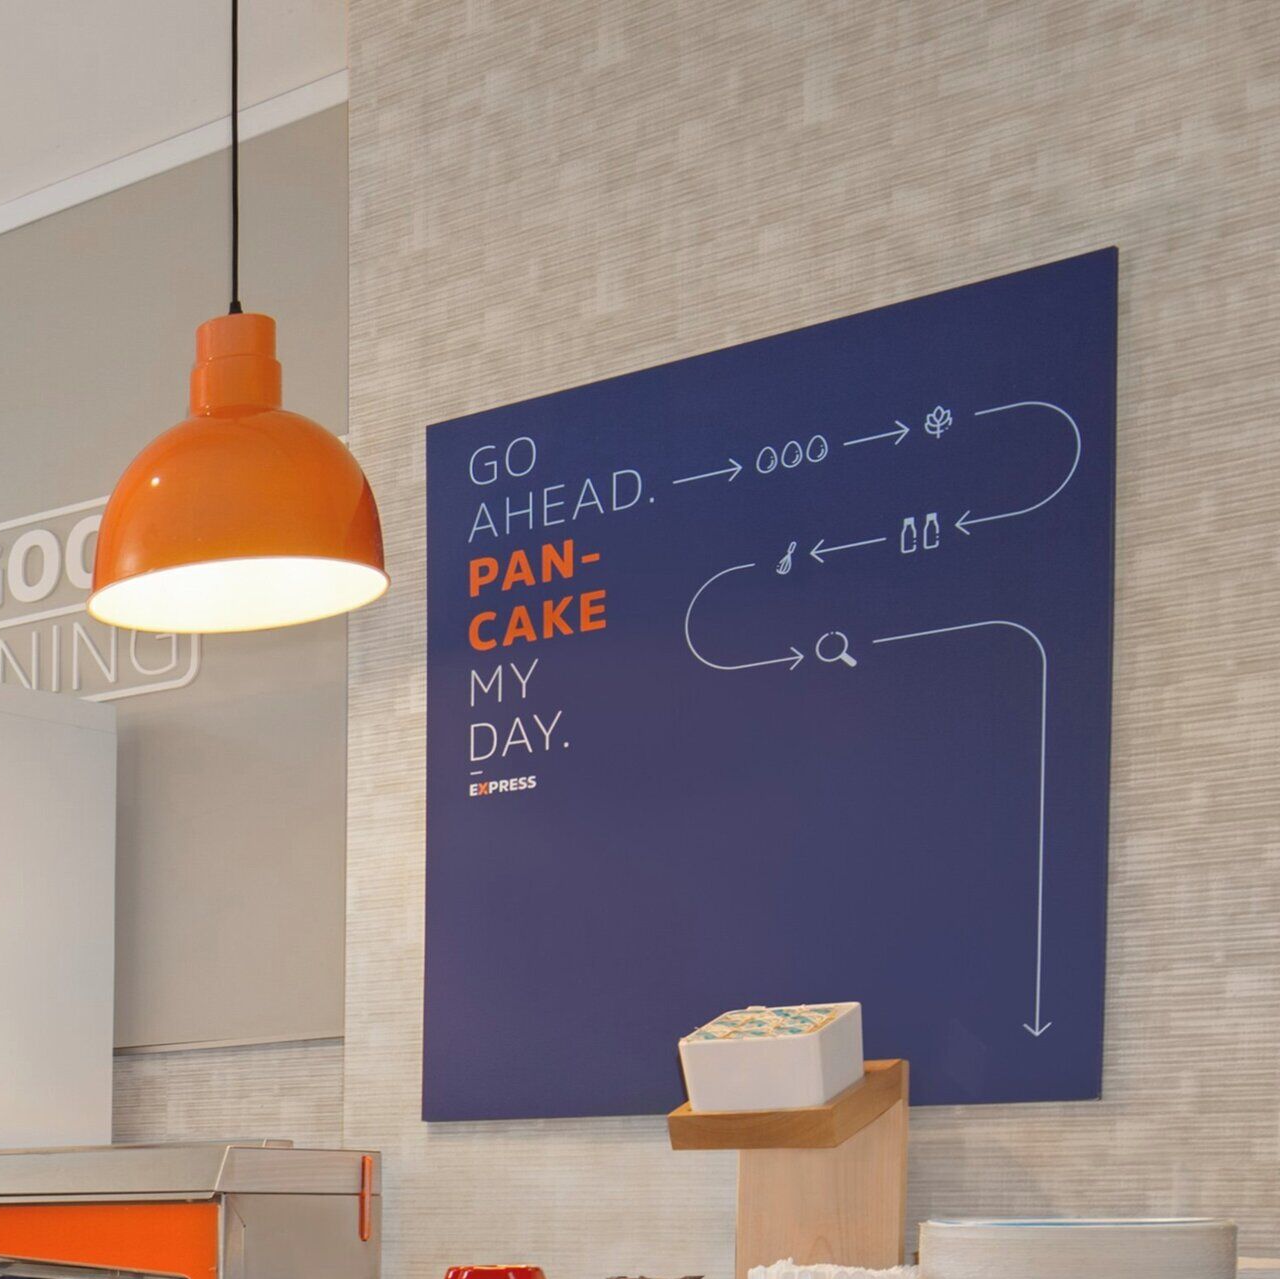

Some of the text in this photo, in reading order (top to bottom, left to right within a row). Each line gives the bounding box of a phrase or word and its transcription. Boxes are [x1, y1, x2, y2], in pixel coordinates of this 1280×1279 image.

[469, 436, 538, 486] GO
[468, 468, 656, 545] AHEAD.
[469, 538, 601, 598] PAN-
[468, 590, 608, 652] CAKE
[470, 658, 540, 708] MY
[470, 710, 572, 763] DAY.
[469, 775, 538, 798] EXPRESS
